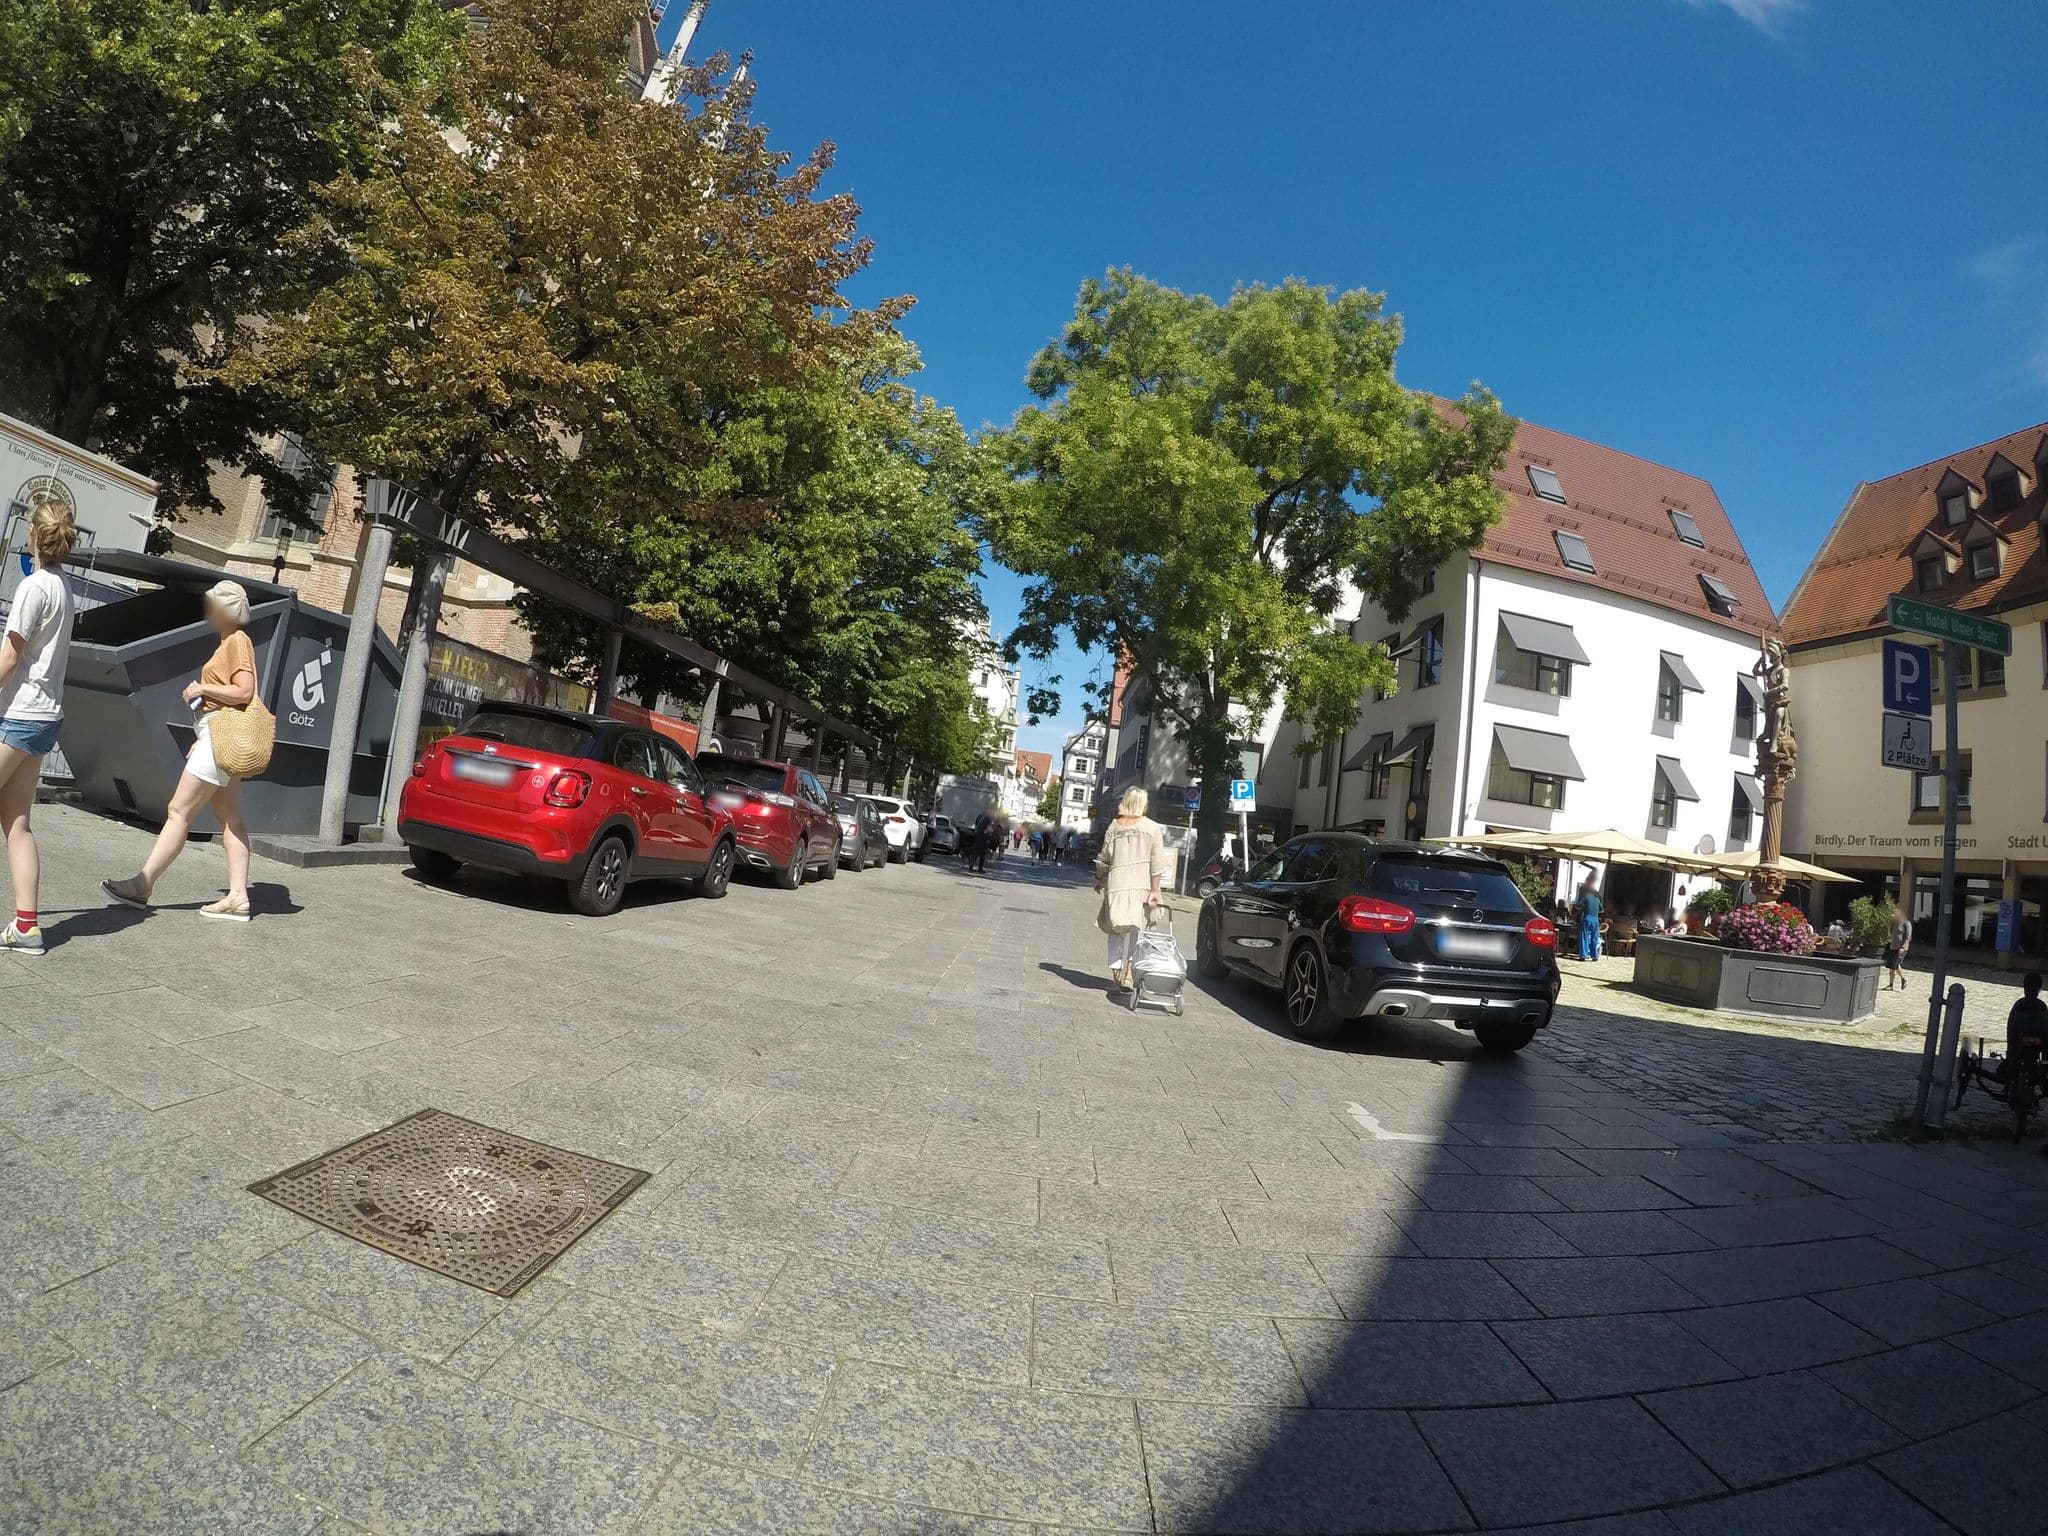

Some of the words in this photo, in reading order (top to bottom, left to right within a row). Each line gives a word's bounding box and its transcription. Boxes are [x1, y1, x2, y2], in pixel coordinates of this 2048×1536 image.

[27, 479, 48, 491] Gold
[1926, 611, 1948, 631] Hotel
[1894, 650, 1920, 702] P
[288, 711, 315, 727] Götz
[1887, 750, 1895, 762] 2
[1897, 751, 1926, 766] Plätze
[1237, 783, 1249, 799] P
[1847, 834, 1867, 846] Der
[1868, 834, 1902, 847] Traum
[1905, 837, 1930, 847] vom
[1934, 835, 1977, 851] Flgen
[2008, 835, 2040, 848] Stadt
